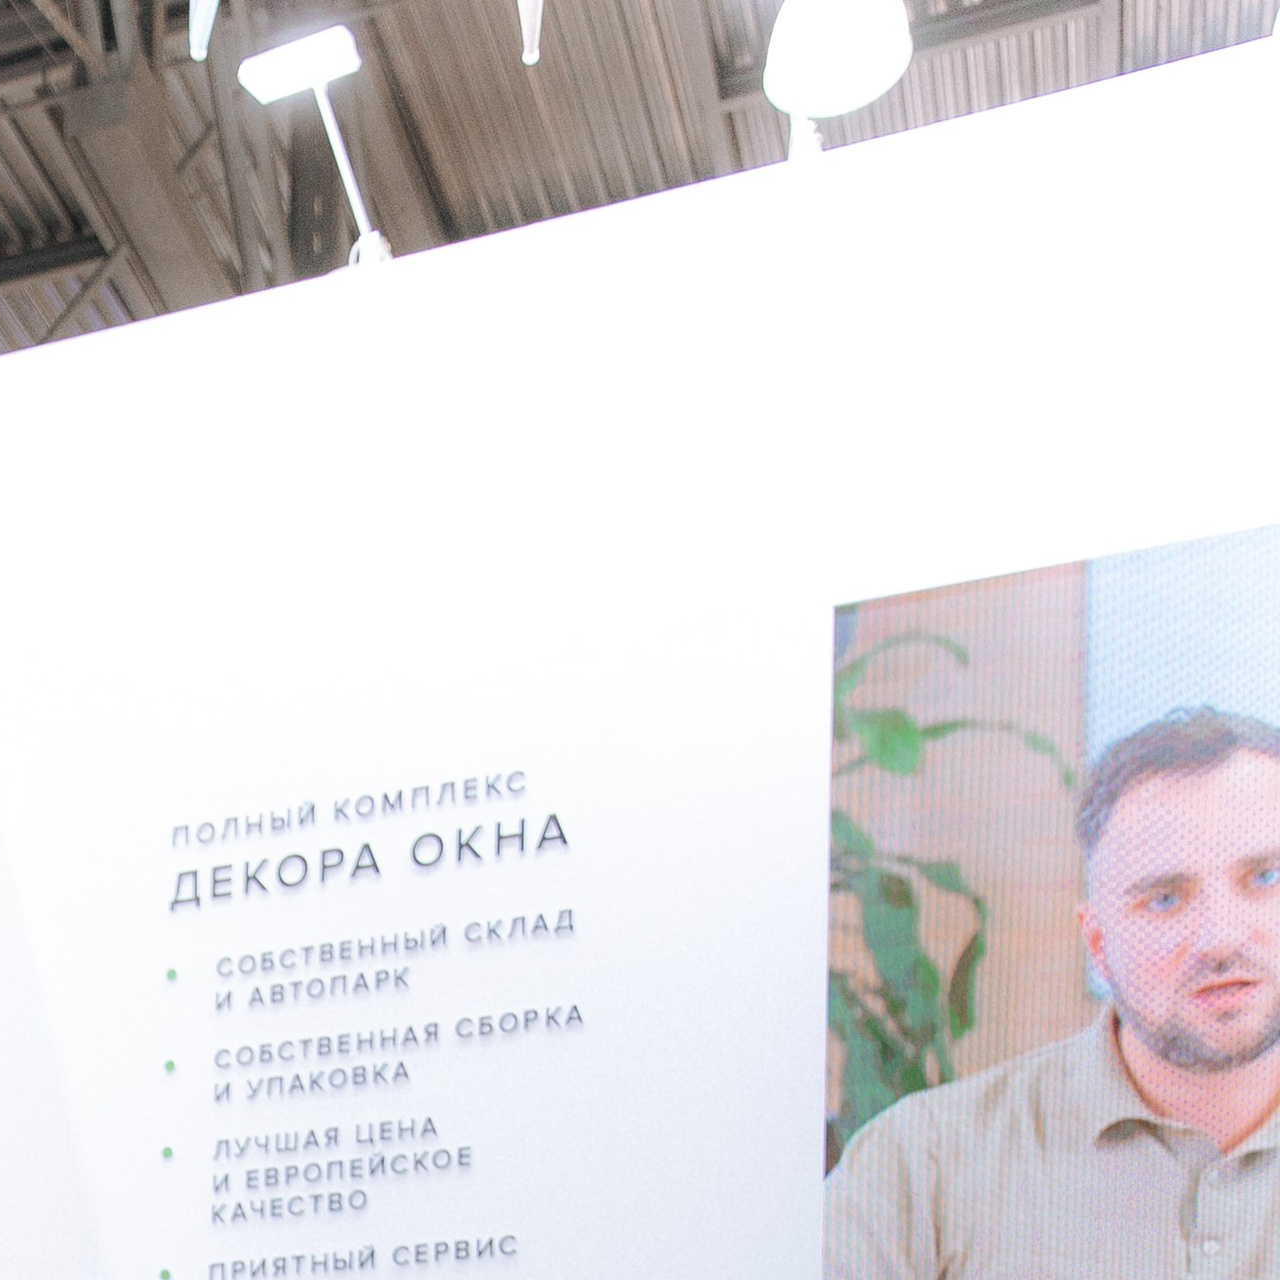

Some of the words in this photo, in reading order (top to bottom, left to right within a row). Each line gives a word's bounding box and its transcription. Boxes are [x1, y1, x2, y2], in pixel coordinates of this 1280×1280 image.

[171, 802, 316, 848] ПОЛНЫЙ
[333, 770, 527, 823] КОМПЛЕКС
[169, 842, 381, 912] ДЕКОРА
[411, 813, 570, 868] ОКНА
[216, 924, 448, 978] СОБСТВЕННЫЙ
[463, 908, 575, 944] СКЛАД
[215, 991, 232, 1011] И
[248, 967, 411, 1009] АВТОПАРК
[214, 1022, 440, 1069] СОБСТВЕННАЯ
[455, 1004, 584, 1041] СБОРКА
[214, 1081, 231, 1102] И
[246, 1061, 410, 1101] УПАКОВКА
[213, 1127, 340, 1160] ЛУЧШАЯ
[355, 1117, 438, 1147] ЦЕНА
[213, 1173, 229, 1193] И
[245, 1147, 473, 1191] ЕВРОПЕЙСКОЕ
[211, 1190, 368, 1224] КАЧЕСТВО
[392, 1235, 518, 1266] СЕРВИС
